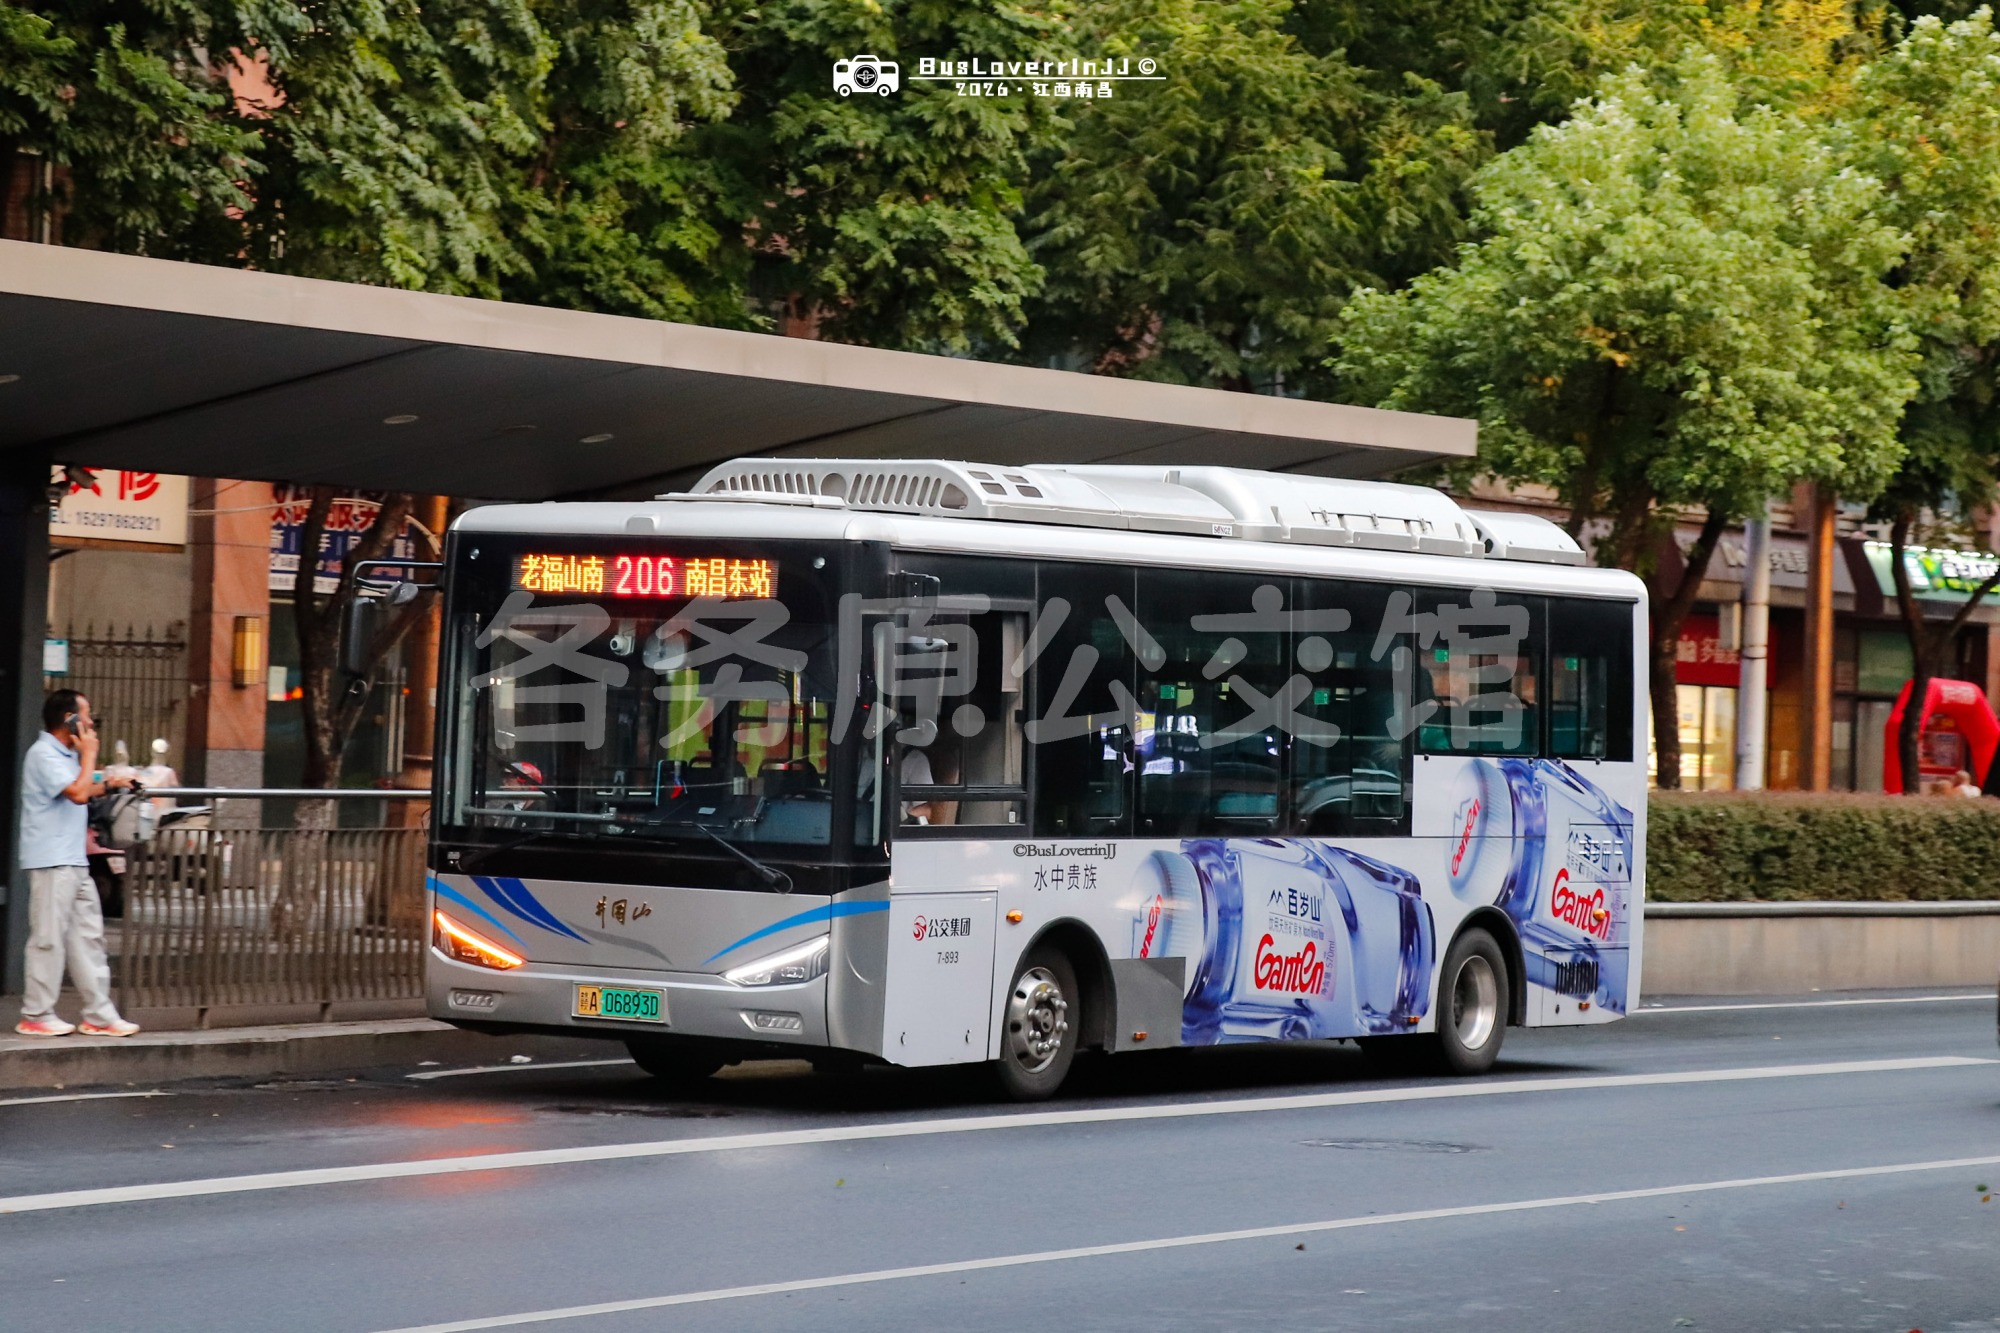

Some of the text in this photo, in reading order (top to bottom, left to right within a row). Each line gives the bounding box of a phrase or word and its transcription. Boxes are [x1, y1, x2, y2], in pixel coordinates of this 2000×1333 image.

[520, 554, 772, 598] 老福山南 206 南昌东站
[1033, 863, 1098, 891] 水中贵族
[1288, 887, 1321, 922] 百岁山
[928, 917, 971, 938] 公交集团
[937, 951, 959, 964] 7-893
[1254, 933, 1325, 995] Ganten
